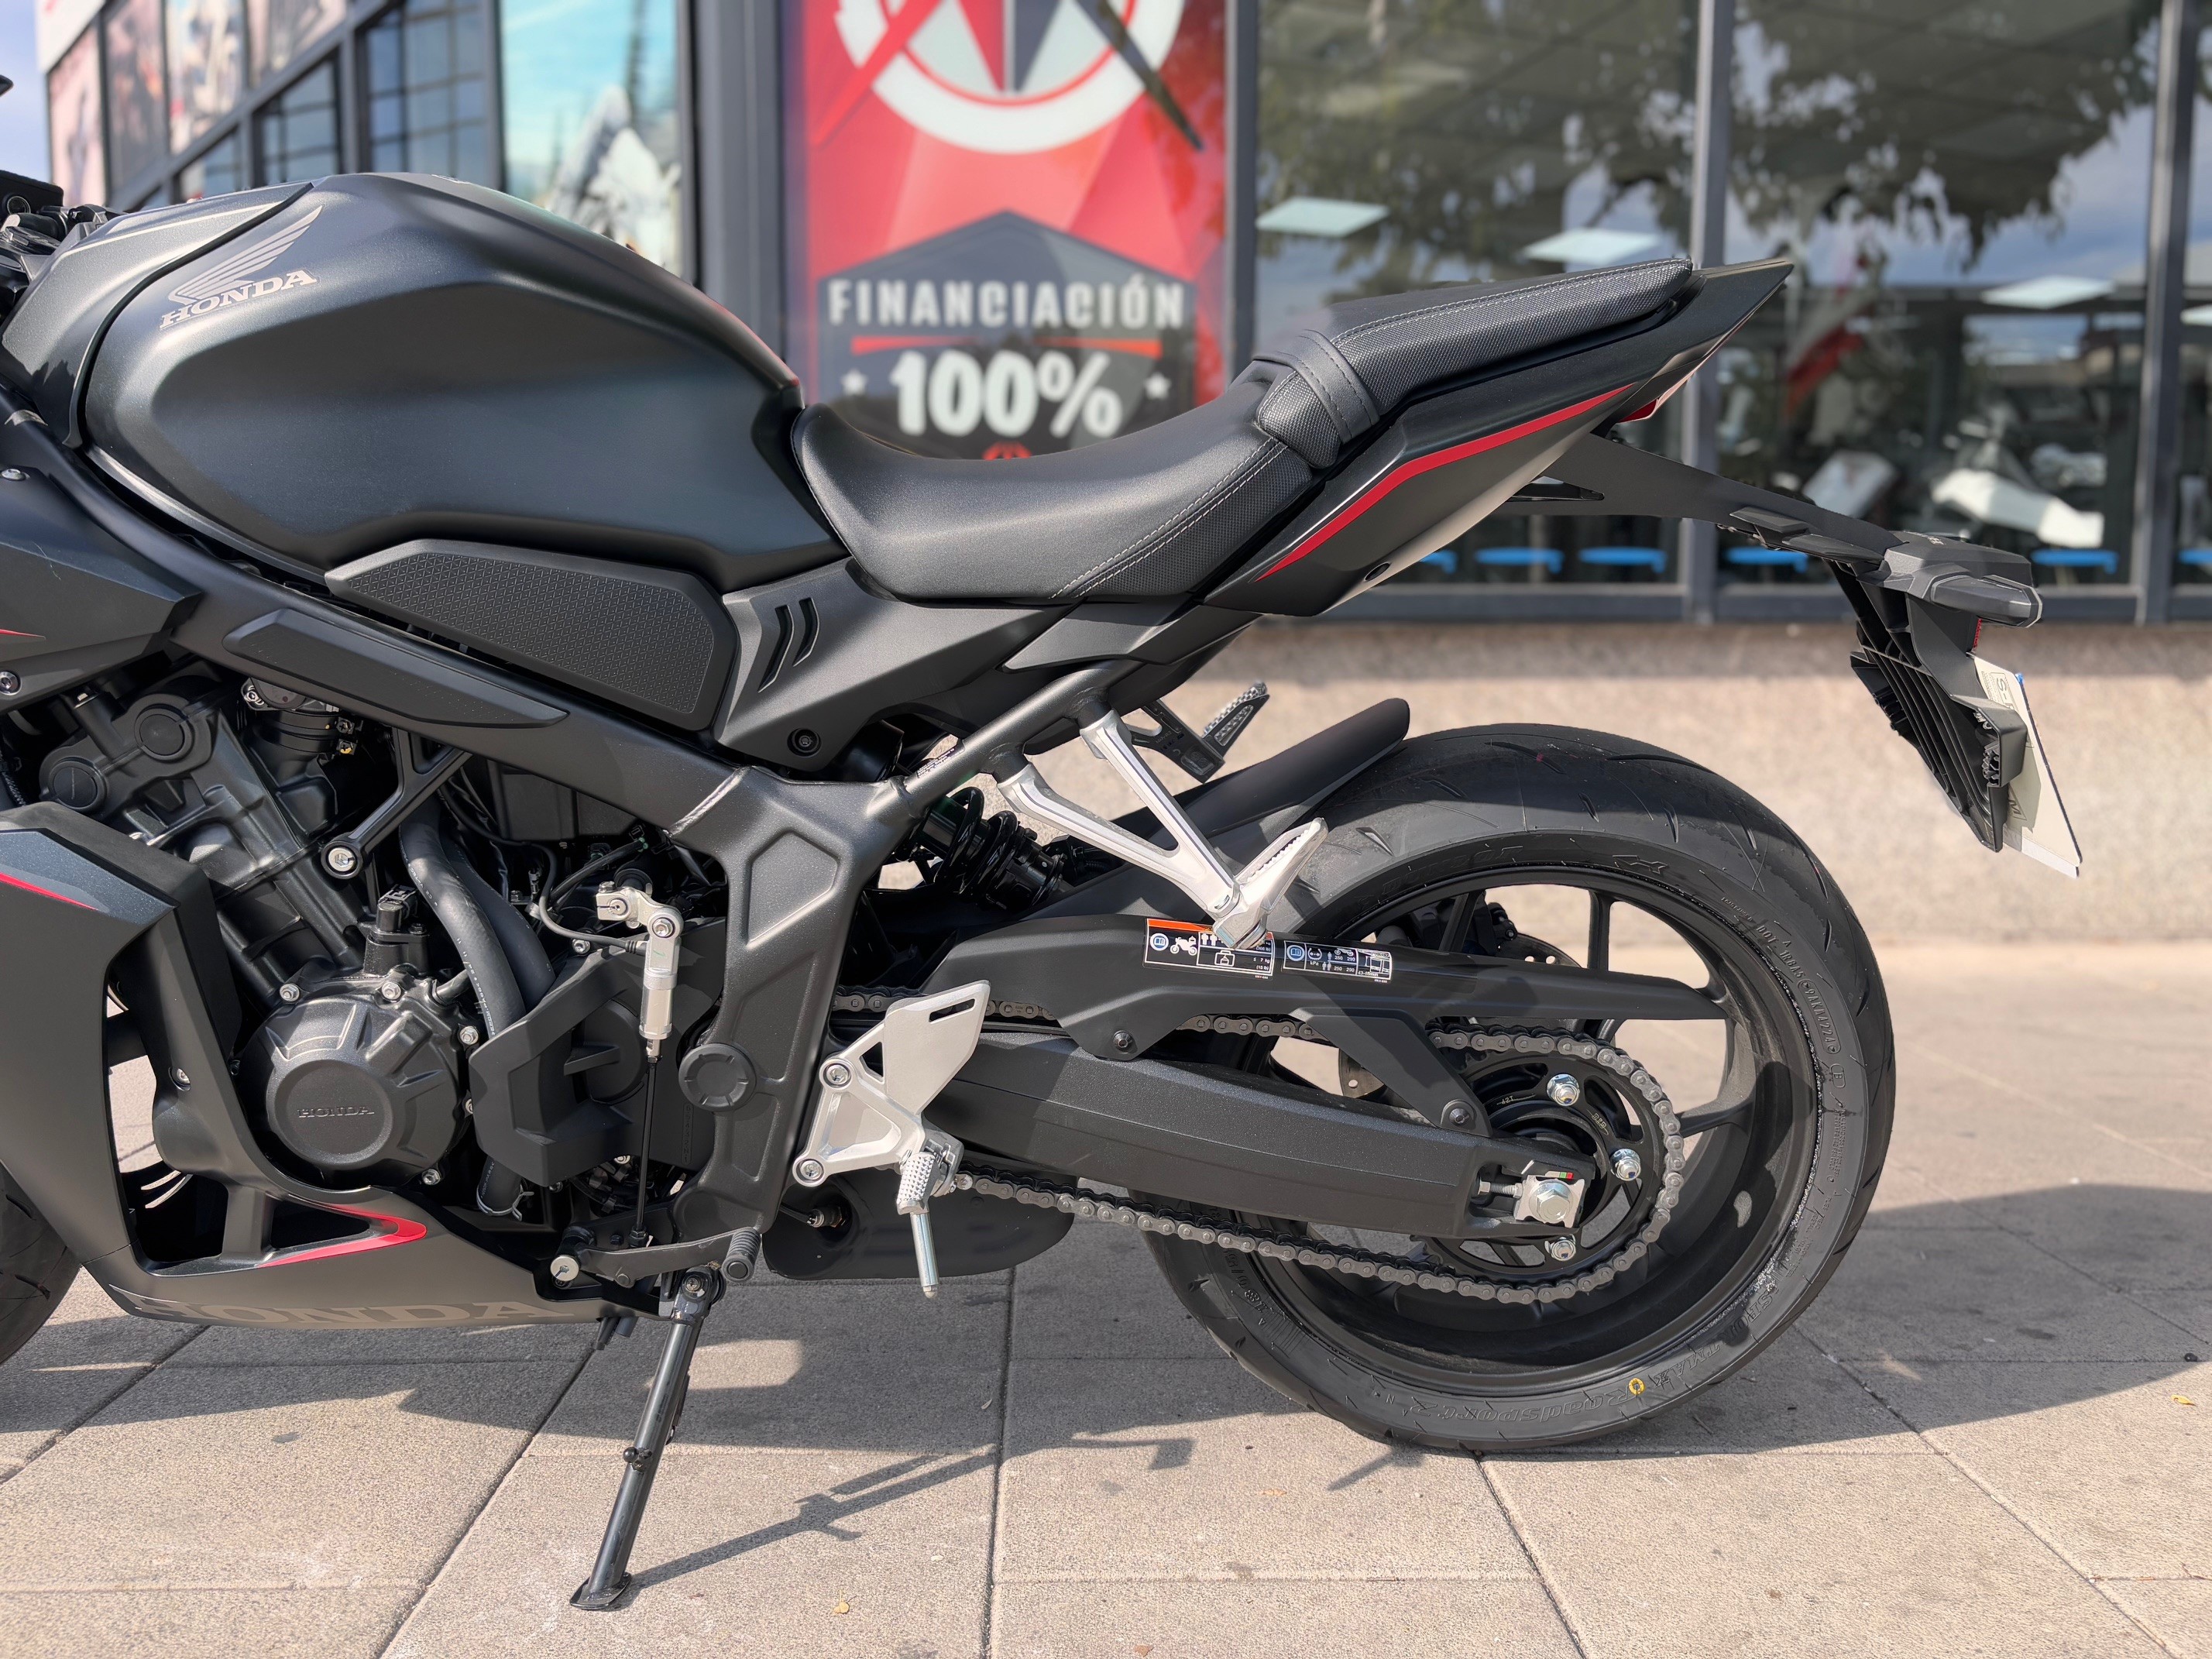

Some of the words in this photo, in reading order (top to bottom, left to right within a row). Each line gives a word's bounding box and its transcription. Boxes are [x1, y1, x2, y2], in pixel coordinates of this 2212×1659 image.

[159, 269, 318, 329] HONDA
[827, 273, 1185, 329] FINANCIACIÓN
[889, 349, 1124, 438] 100%
[297, 1106, 375, 1118] HONDA
[108, 1283, 574, 1324] HONDA
